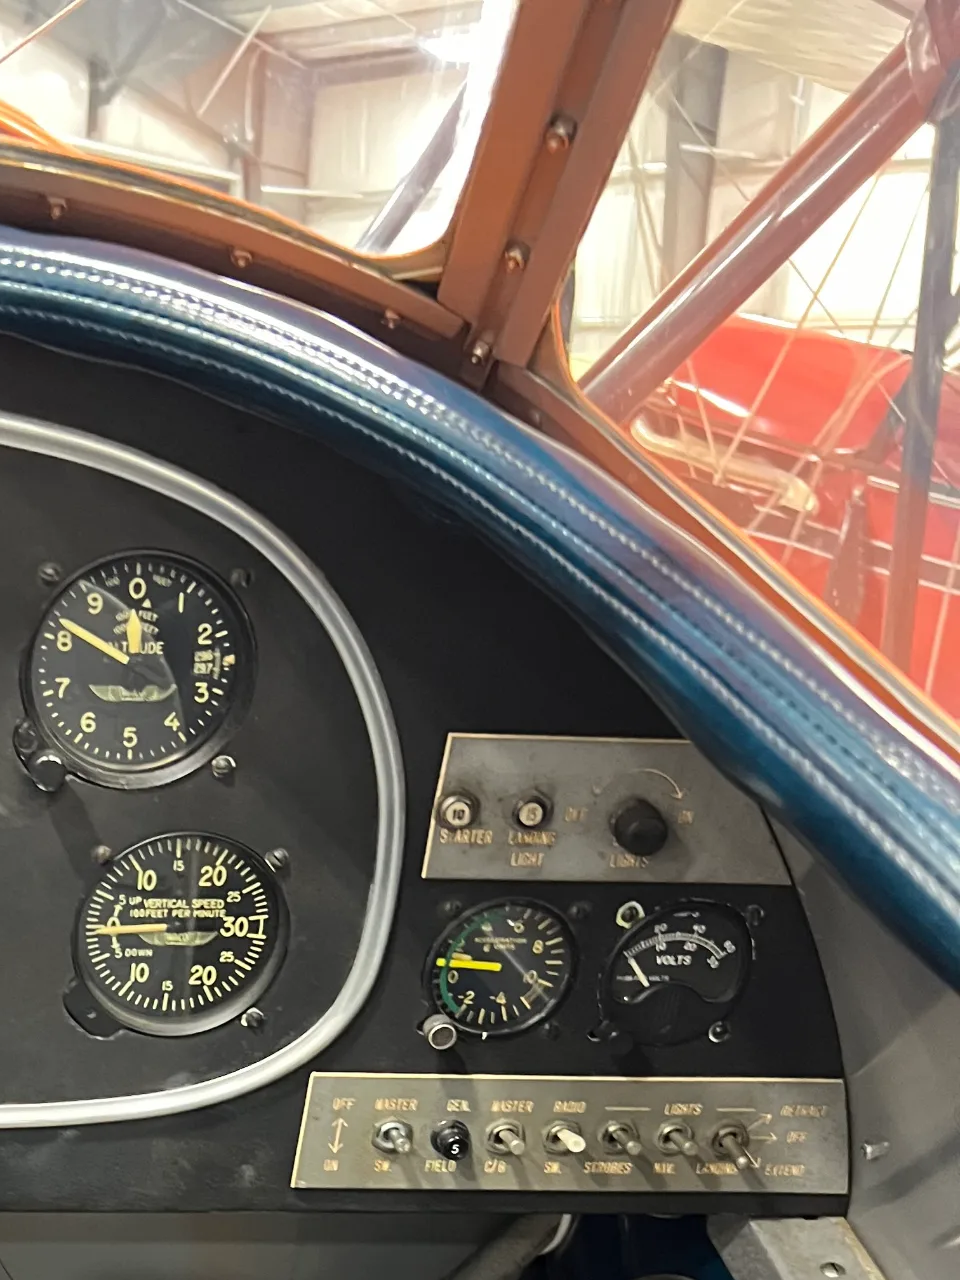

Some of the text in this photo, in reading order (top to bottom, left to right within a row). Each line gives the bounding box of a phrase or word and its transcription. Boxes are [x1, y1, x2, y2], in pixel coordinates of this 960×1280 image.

[129, 577, 146, 599] 0
[87, 593, 103, 614] 9
[178, 592, 184, 613] 1
[197, 623, 212, 645] 2
[56, 631, 72, 652] 8
[55, 677, 70, 698] 7
[194, 682, 209, 703] 3
[80, 712, 96, 732] 6
[164, 712, 179, 731] 4
[123, 727, 138, 747] 5
[173, 860, 184, 871] 15
[137, 869, 157, 891] 10
[199, 865, 227, 886] 20
[119, 894, 142, 906] 5 UP
[143, 898, 225, 909] VERTICAL SPEED
[227, 891, 241, 903] 25
[171, 909, 191, 918] PER
[193, 909, 227, 918] MINUTE
[220, 917, 248, 937] 30
[115, 948, 153, 958] 5 DOWN
[532, 939, 544, 954] 8
[220, 951, 235, 963] 25
[656, 955, 692, 966] VOLTS
[130, 963, 149, 983] 10
[188, 965, 217, 985] 20
[447, 970, 459, 984] 0
[162, 981, 173, 991] 15
[332, 1098, 356, 1111] OFF
[374, 1099, 418, 1112] MASTER
[491, 1100, 534, 1113] MASTER
[663, 1103, 703, 1116] LIGHTS
[323, 1160, 338, 1171] ON
[425, 1160, 457, 1173] FIELD
[584, 1162, 632, 1175] STROBES
